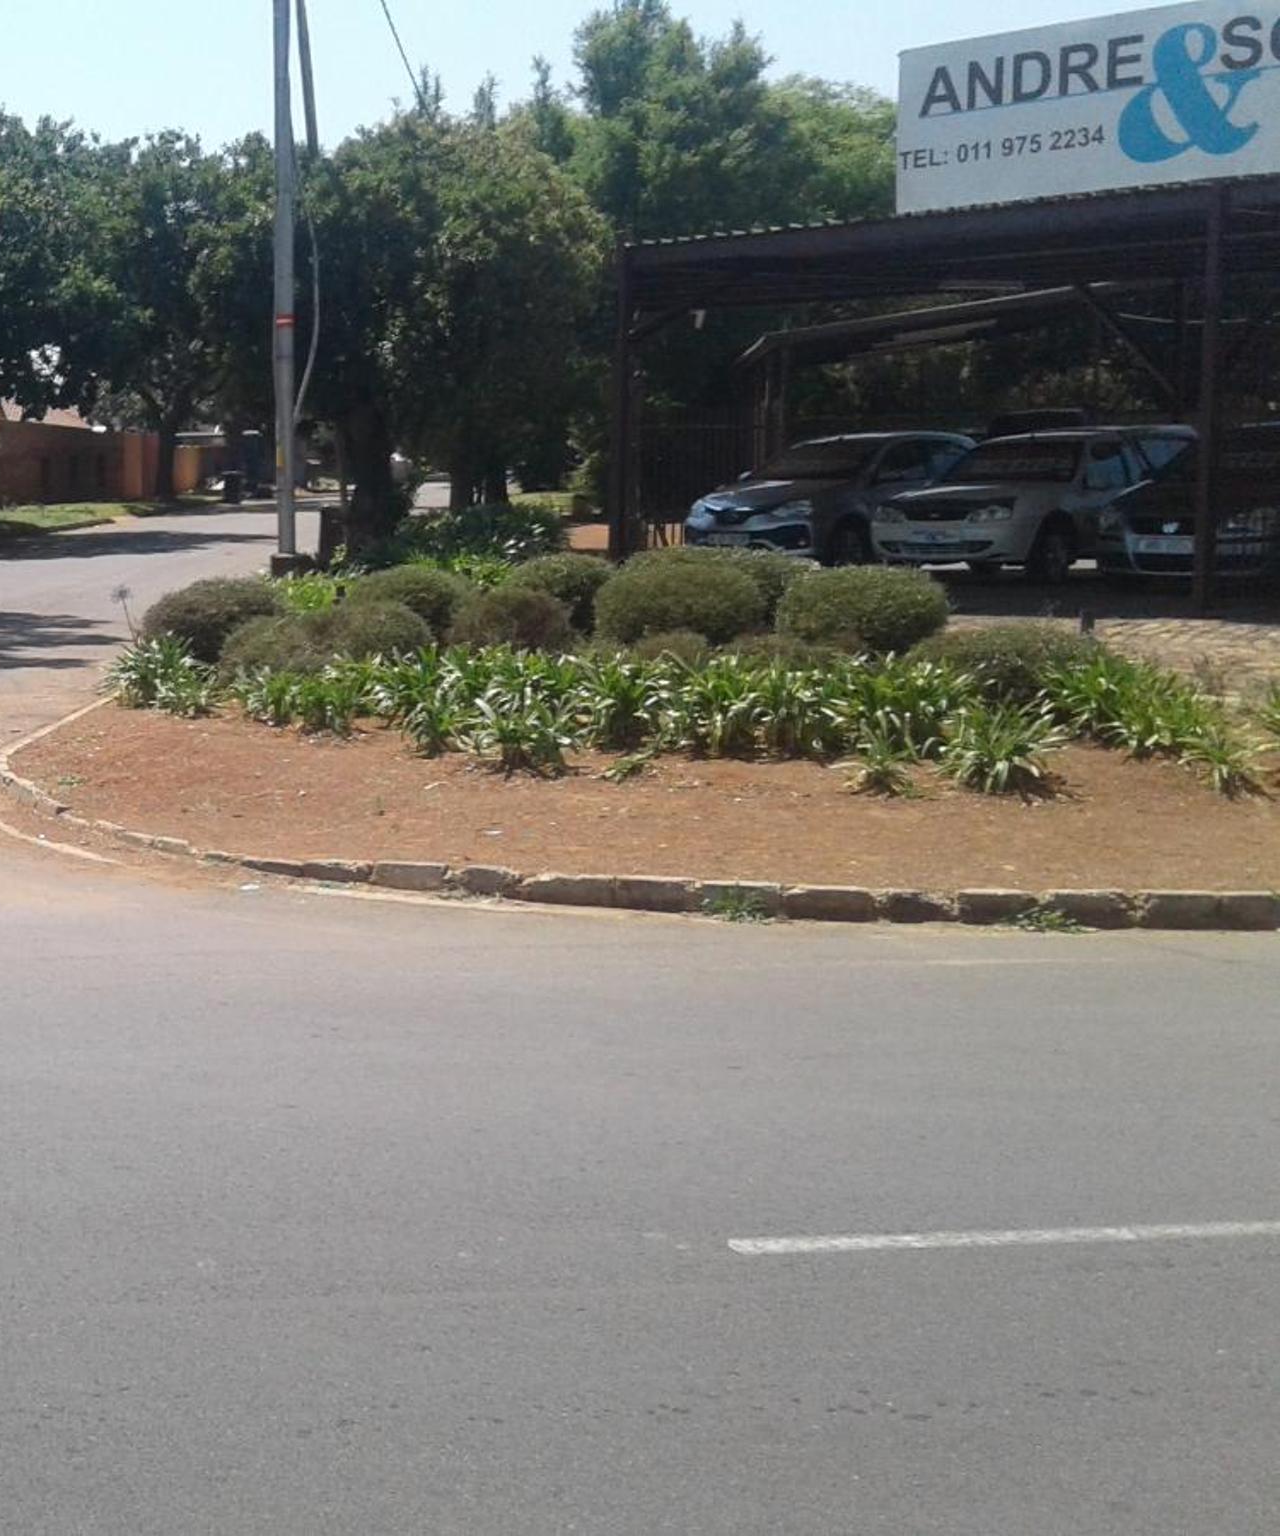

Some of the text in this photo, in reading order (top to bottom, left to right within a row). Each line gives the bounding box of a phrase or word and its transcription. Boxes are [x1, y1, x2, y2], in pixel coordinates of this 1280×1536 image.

[918, 34, 1145, 118] ANDRE
[1220, 15, 1280, 70] S
[898, 124, 1106, 170] TEL: 011 975 2234
